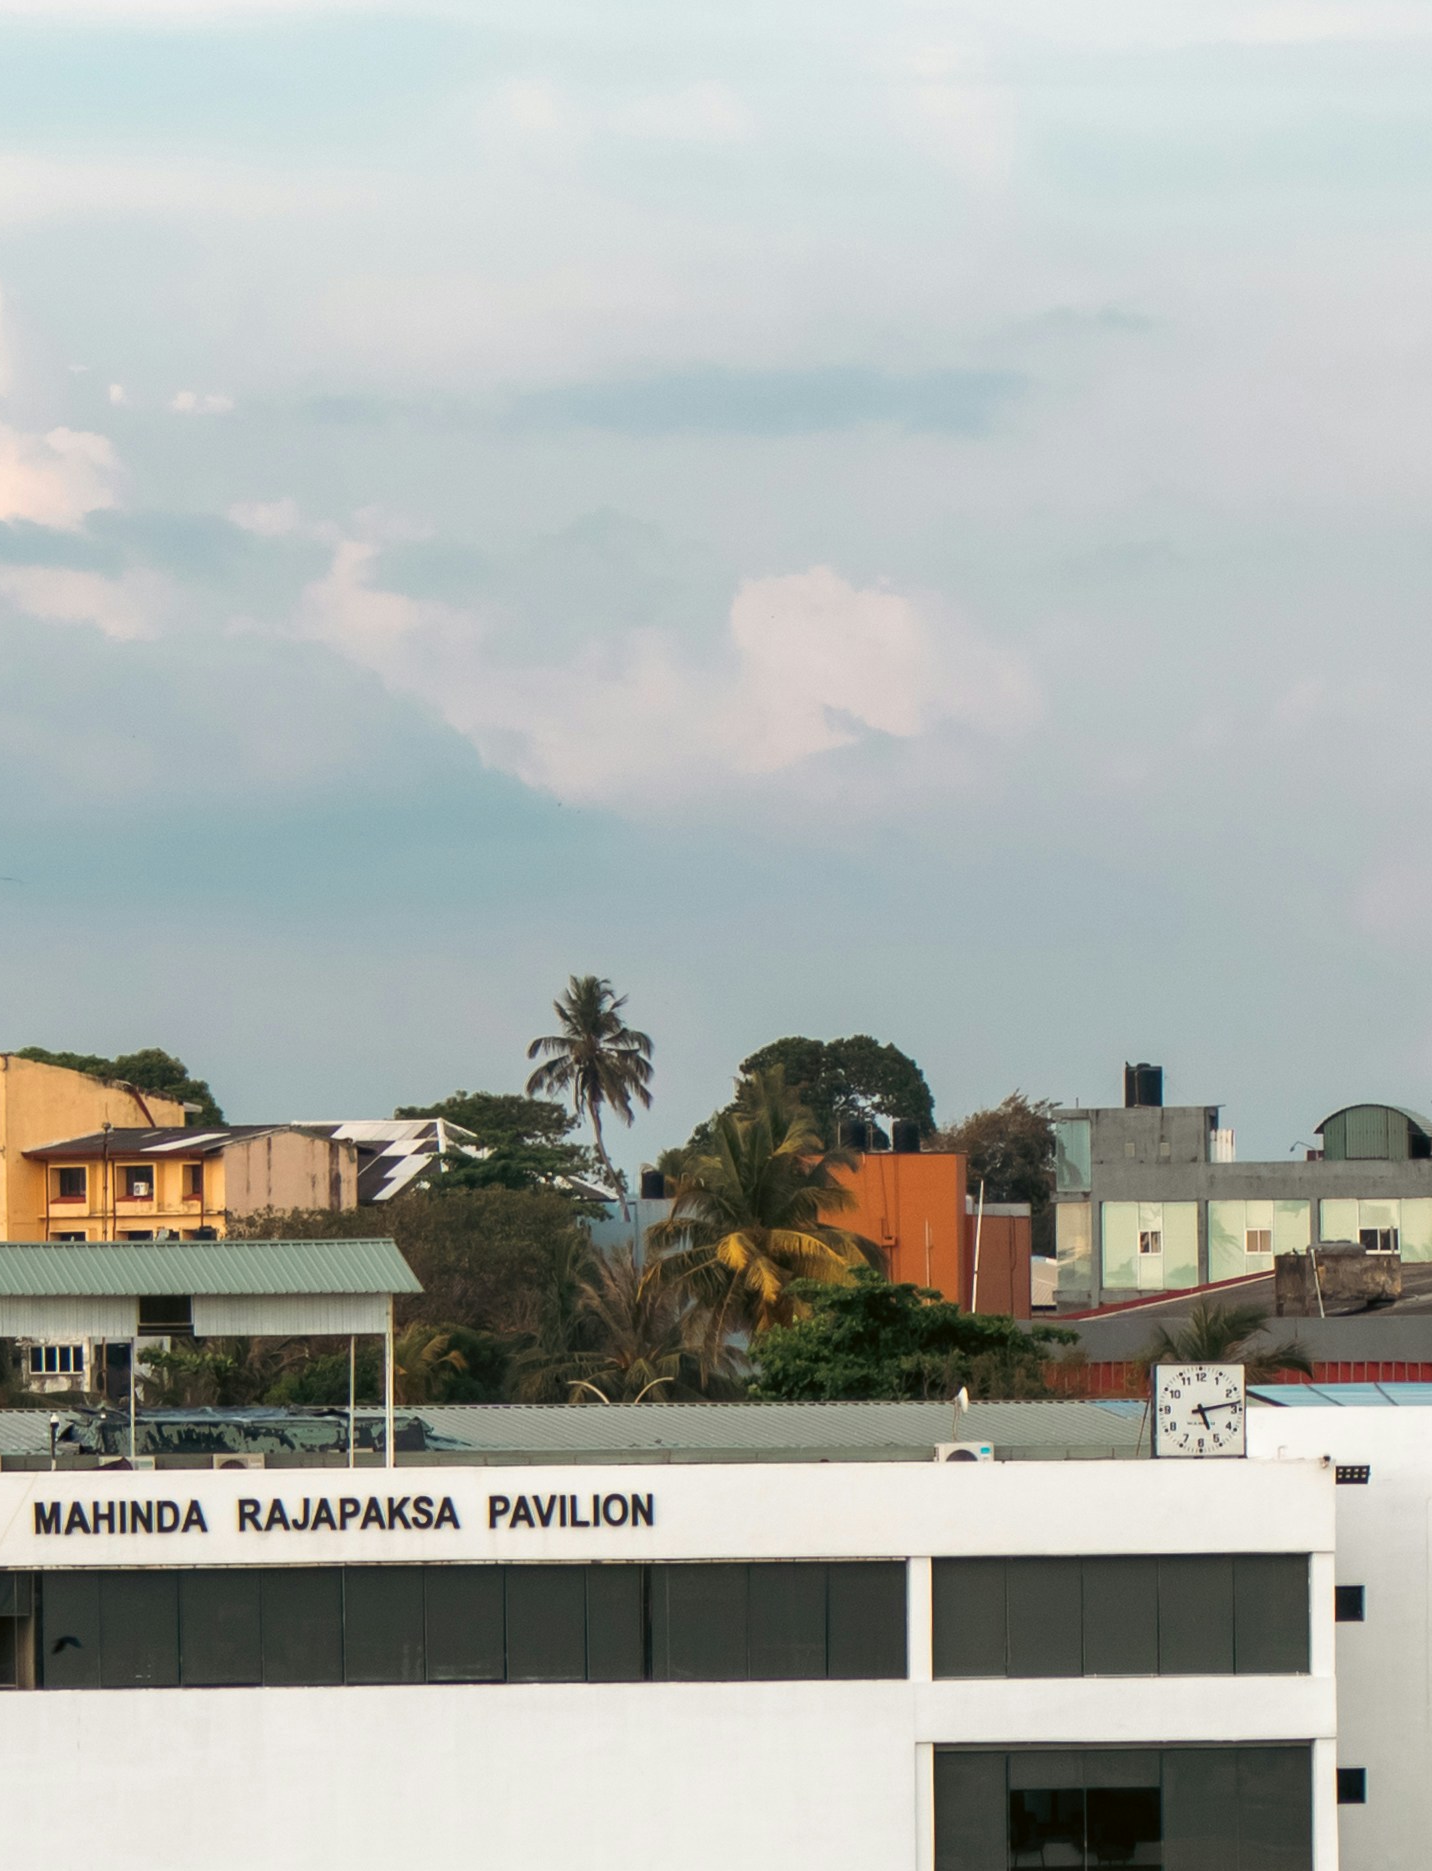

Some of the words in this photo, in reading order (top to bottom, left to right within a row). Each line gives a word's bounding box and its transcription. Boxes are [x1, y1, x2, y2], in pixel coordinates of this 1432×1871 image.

[1182, 1377, 1191, 1385] 11
[1196, 1373, 1206, 1382] 12
[1215, 1377, 1218, 1385] 1
[1170, 1390, 1180, 1399] 10
[1226, 1389, 1232, 1398] 2
[1165, 1406, 1171, 1414] 9
[1231, 1405, 1237, 1414] 3
[1170, 1422, 1176, 1431] 8
[1226, 1422, 1232, 1430] 4
[1184, 1434, 1189, 1442] 7
[1213, 1434, 1219, 1443] 5
[1198, 1439, 1204, 1447] 6
[34, 1499, 207, 1534] MAHINDA
[238, 1496, 460, 1532] RAJAPAKSA
[488, 1492, 654, 1529] PAVILION
